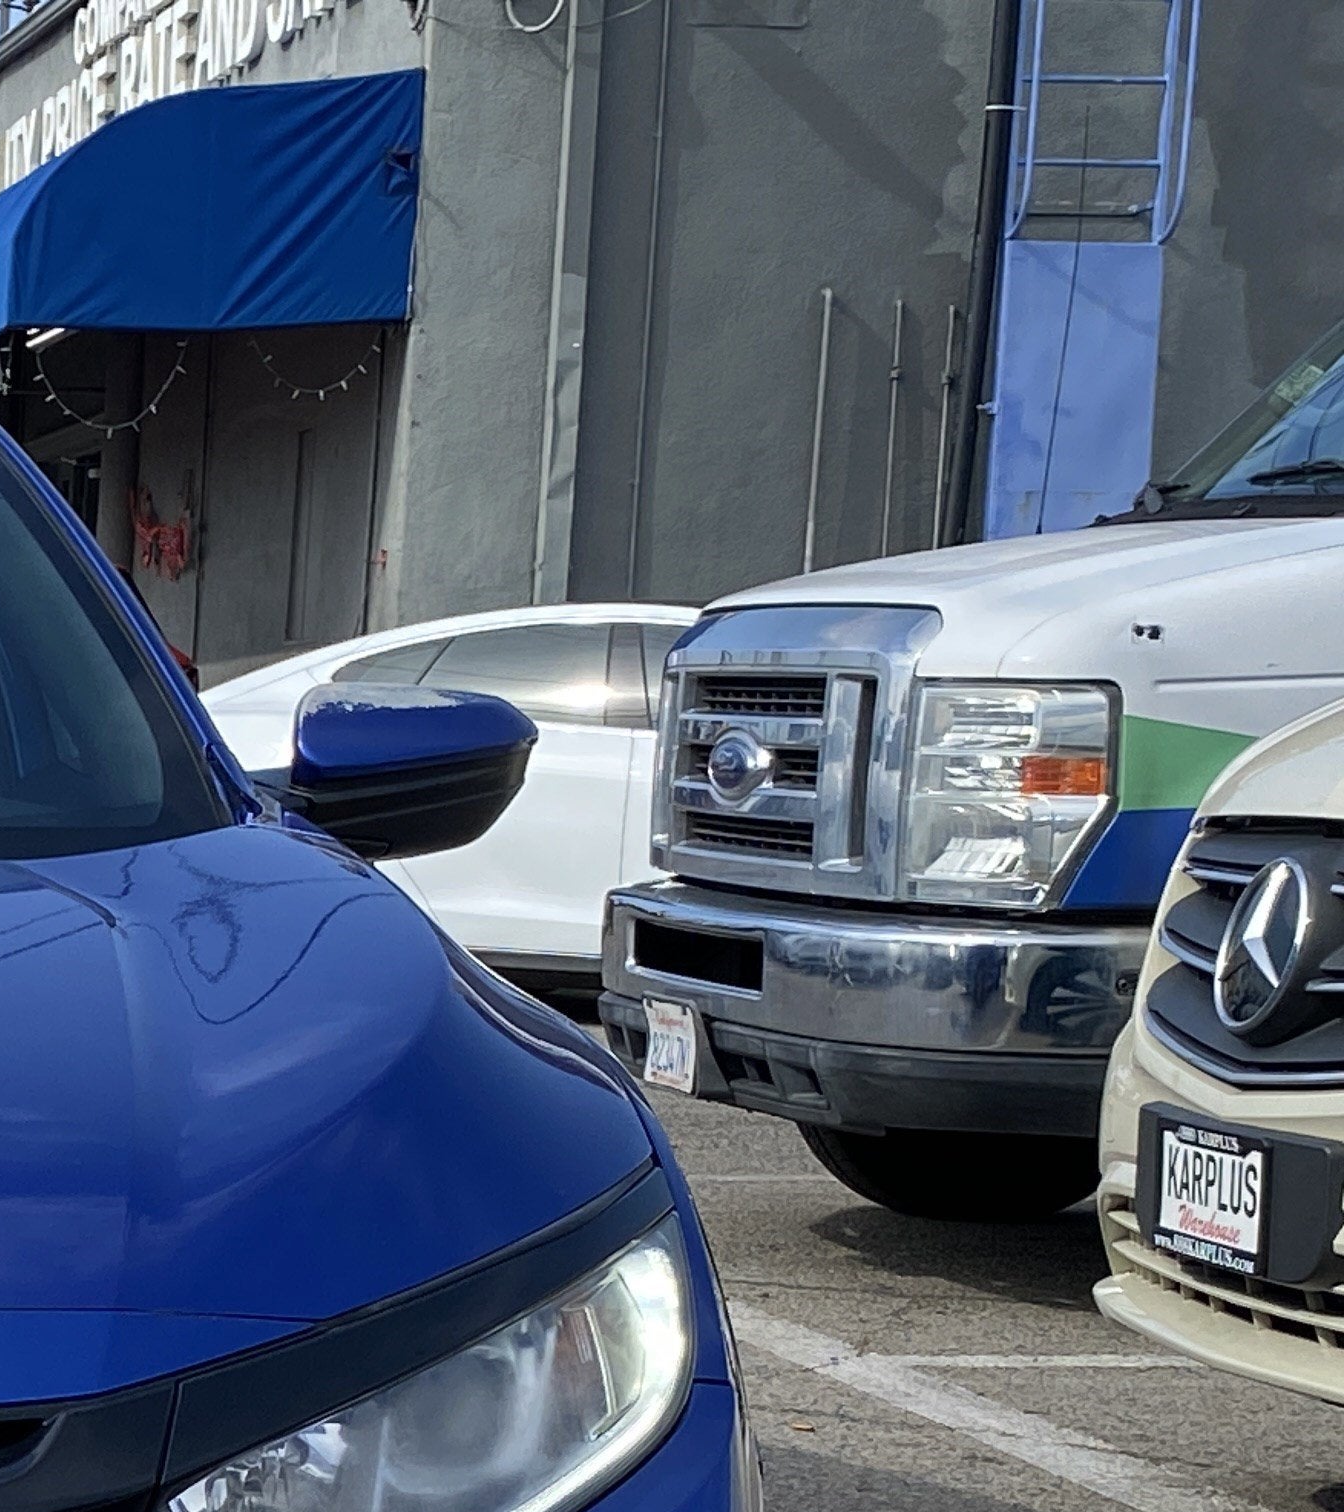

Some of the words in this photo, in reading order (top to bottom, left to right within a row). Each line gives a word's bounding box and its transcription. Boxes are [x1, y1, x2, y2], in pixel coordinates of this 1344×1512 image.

[40, 55, 110, 165] PRICE
[120, 0, 190, 118] RATE
[191, 0, 258, 91] AND
[1167, 1143, 1259, 1219] KARPLUS
